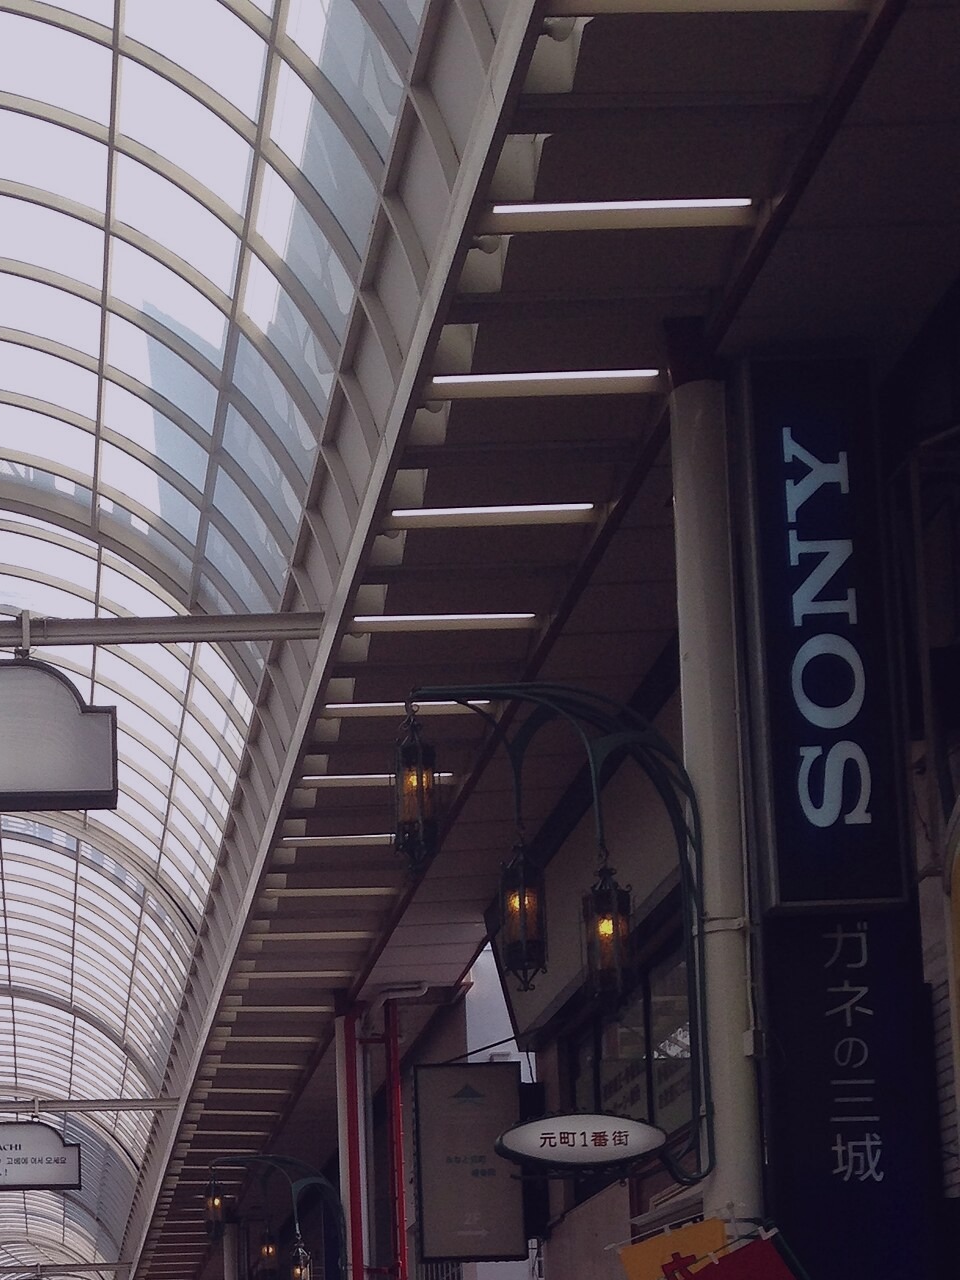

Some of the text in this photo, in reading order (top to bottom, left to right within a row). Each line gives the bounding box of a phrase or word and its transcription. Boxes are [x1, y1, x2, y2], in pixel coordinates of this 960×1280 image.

[781, 426, 872, 828] SONY
[539, 1130, 630, 1148] 元町1番街
[821, 920, 885, 1183] ガネの三城
